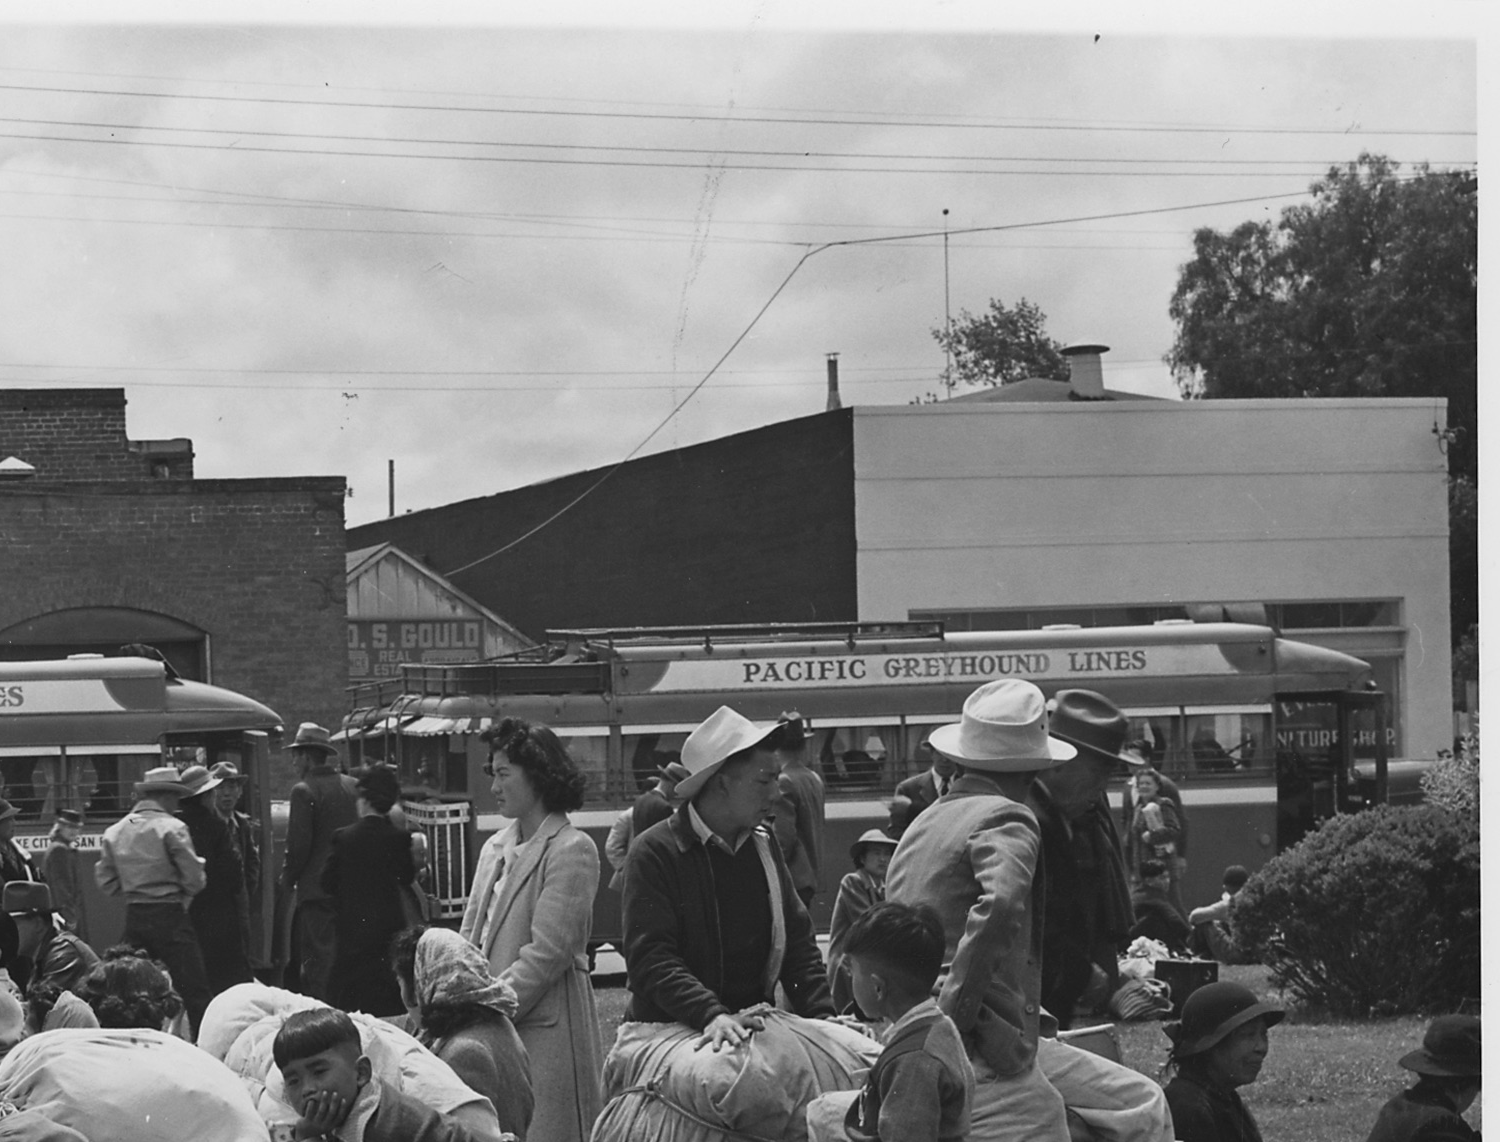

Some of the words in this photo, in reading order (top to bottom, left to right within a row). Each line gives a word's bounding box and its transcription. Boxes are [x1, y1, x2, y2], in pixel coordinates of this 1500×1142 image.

[372, 623, 395, 648] S.
[400, 622, 479, 648] GOULD
[379, 650, 412, 662] REAL
[742, 659, 867, 683] PACIFIC
[883, 653, 1050, 678] GREYHOUND
[1068, 650, 1147, 672] LINES
